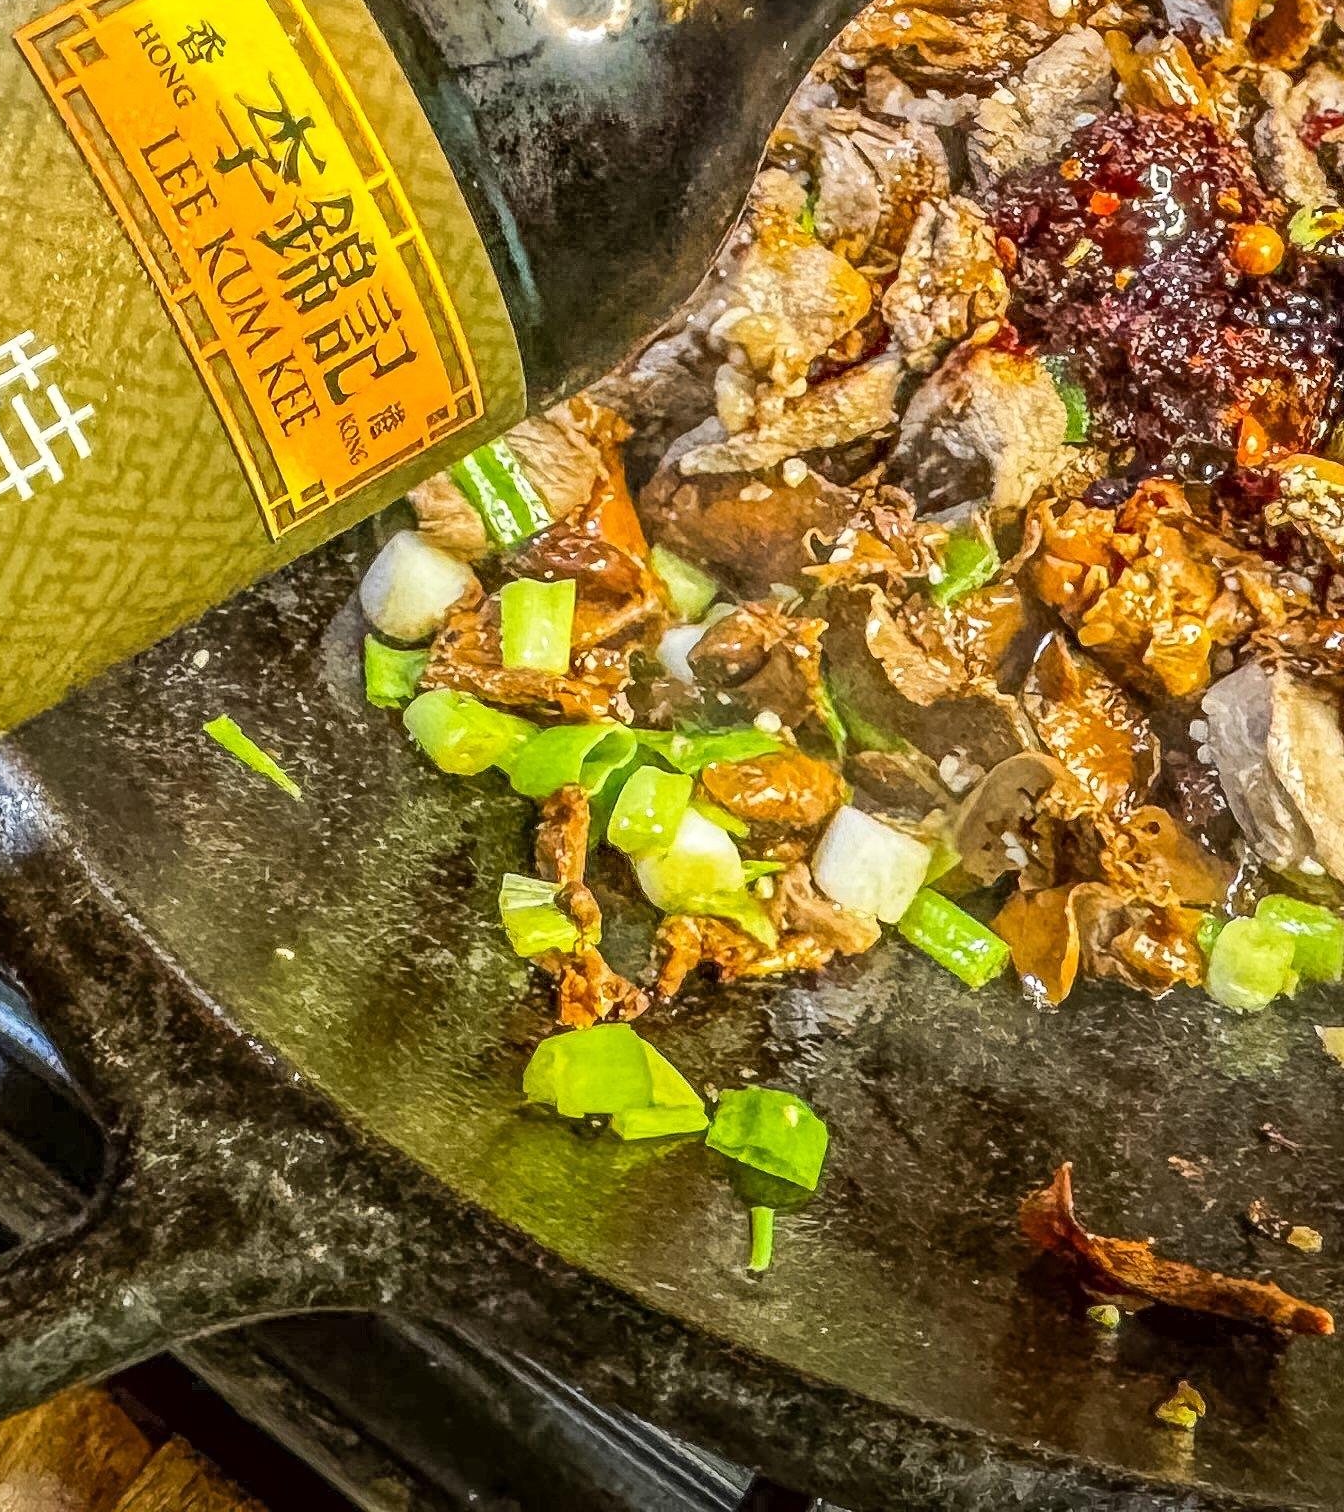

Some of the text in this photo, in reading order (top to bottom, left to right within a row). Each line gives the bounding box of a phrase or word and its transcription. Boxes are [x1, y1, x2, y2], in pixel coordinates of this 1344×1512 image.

[133, 22, 197, 110] HONG
[176, 19, 228, 65] 香
[140, 125, 322, 437] LEE KUM KEE
[212, 71, 418, 407] 李錦記
[336, 412, 368, 467] KONG
